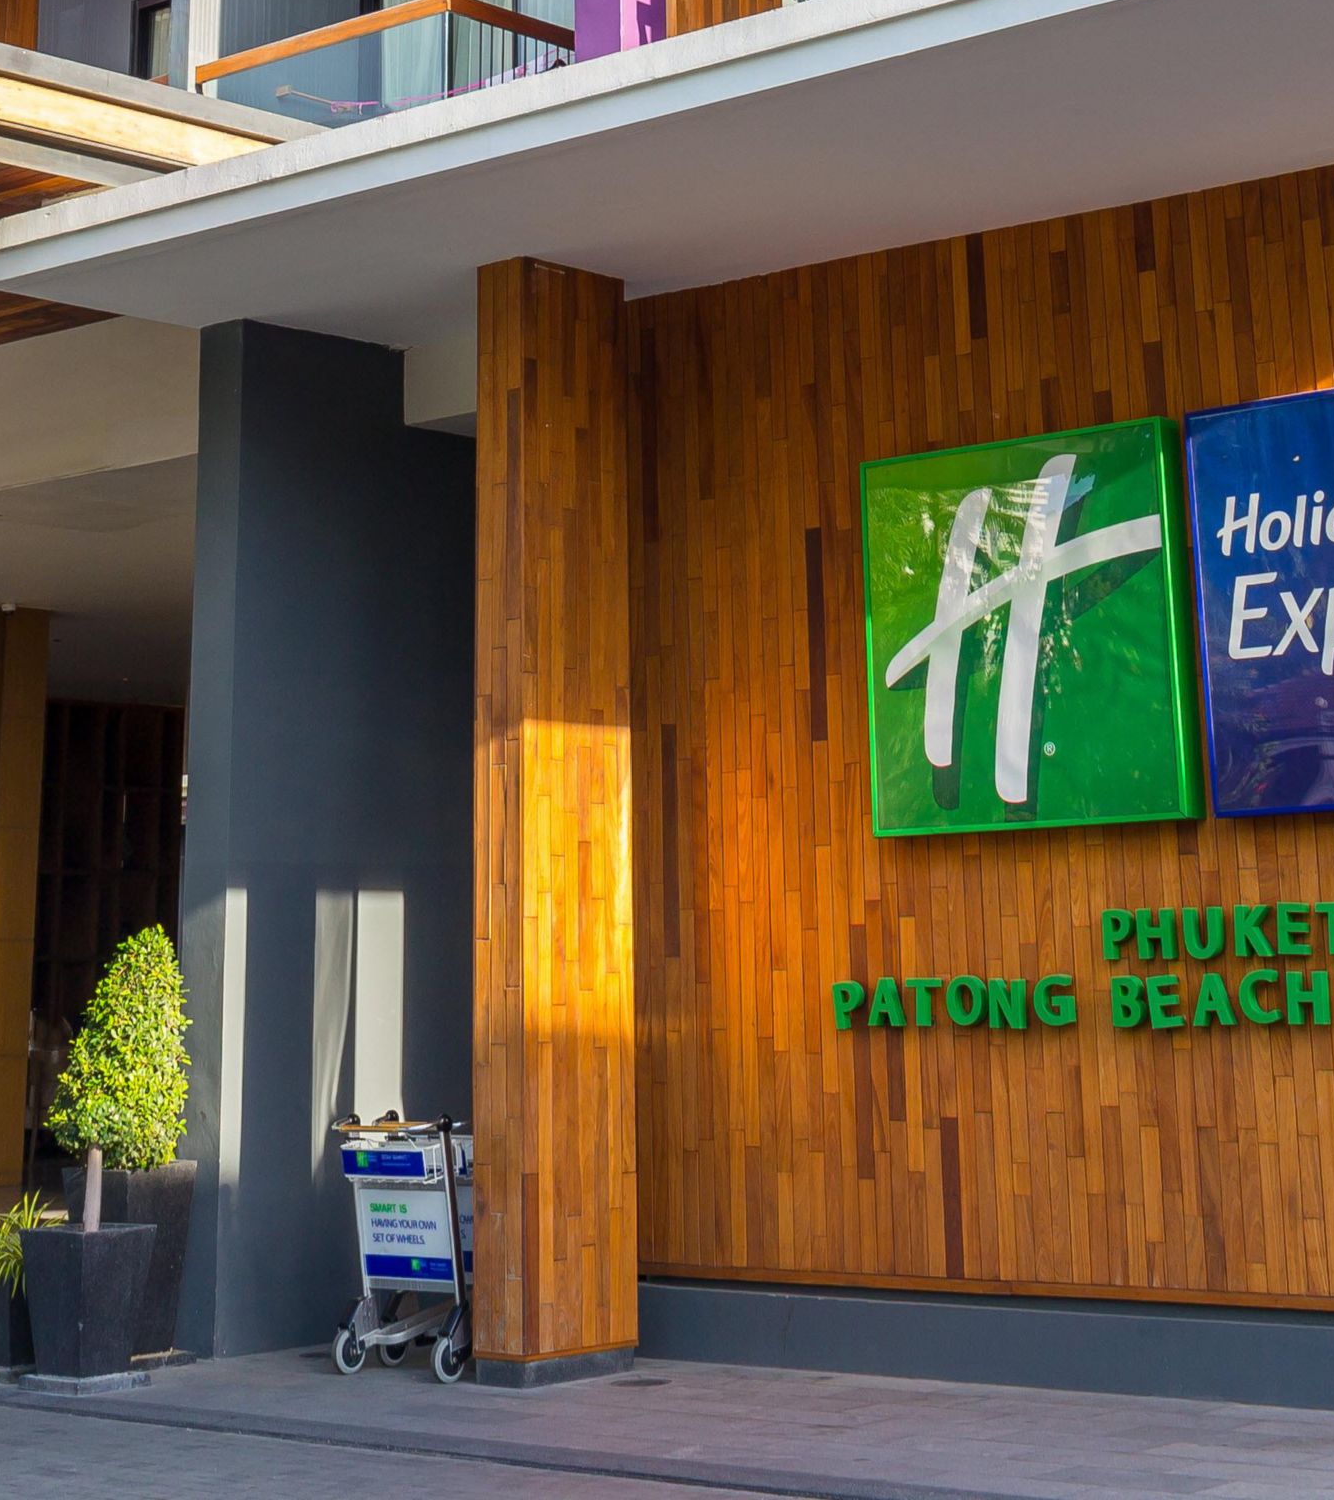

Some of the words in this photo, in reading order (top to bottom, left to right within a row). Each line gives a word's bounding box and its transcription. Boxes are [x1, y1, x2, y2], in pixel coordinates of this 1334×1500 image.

[831, 973, 1078, 1031] PATONG
[1110, 968, 1332, 1030] BEACH
[370, 1203, 396, 1212] SMART
[399, 1204, 407, 1213] IS
[371, 1218, 398, 1228] HAVING
[398, 1219, 417, 1229] YOUR
[418, 1220, 436, 1230] OWN
[373, 1233, 384, 1242] SET
[386, 1233, 395, 1243] OF
